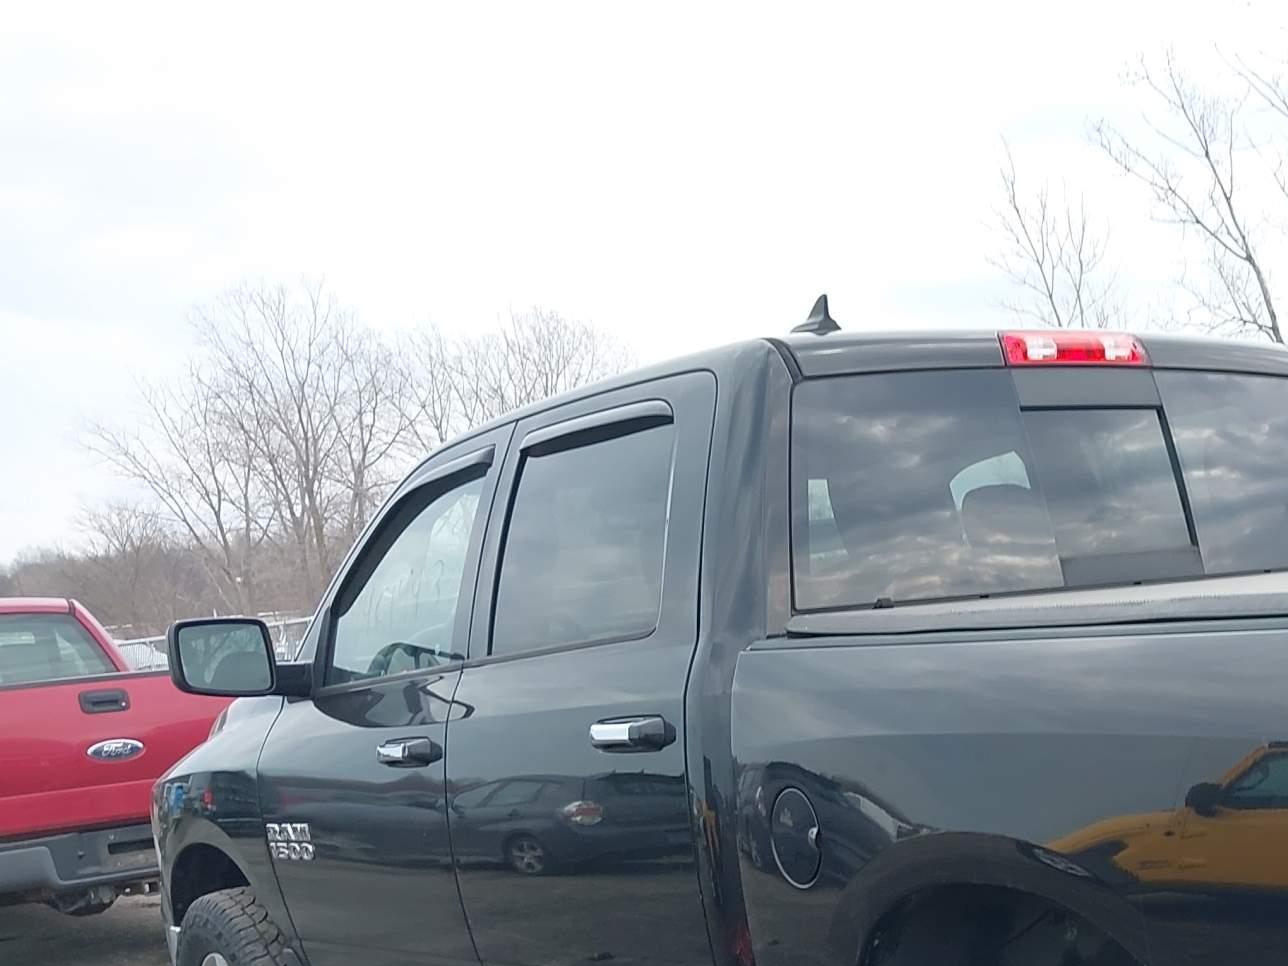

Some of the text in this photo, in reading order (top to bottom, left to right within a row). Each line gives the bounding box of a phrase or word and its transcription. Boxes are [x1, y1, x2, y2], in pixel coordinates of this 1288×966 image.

[102, 742, 132, 757] Ford
[265, 823, 311, 841] RAM
[270, 842, 315, 861] 1500
